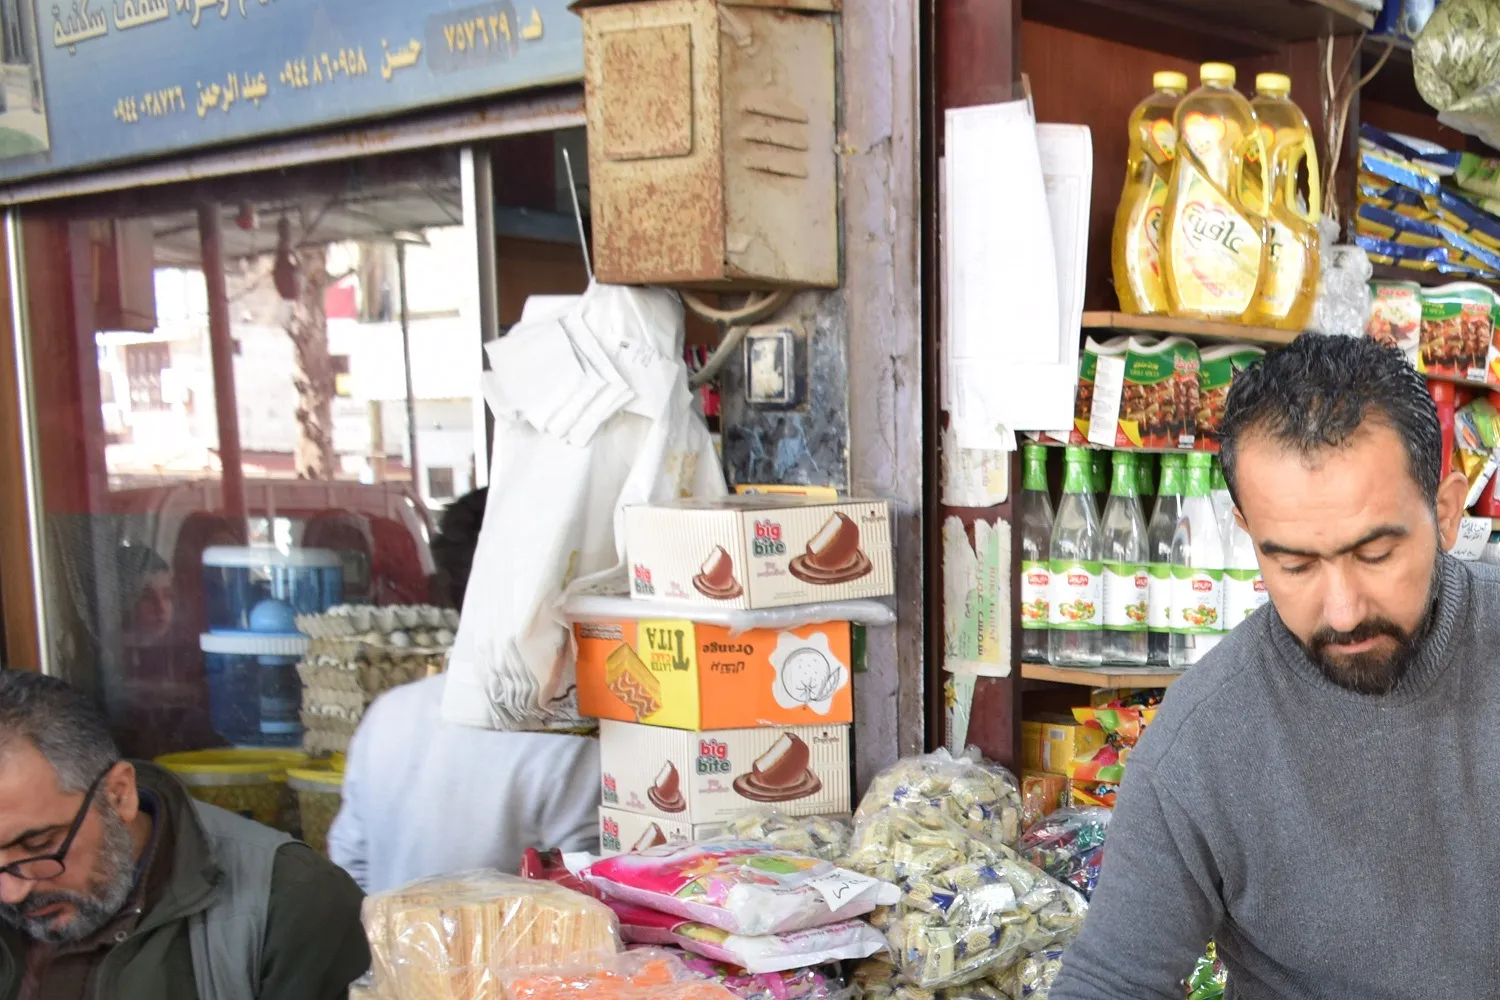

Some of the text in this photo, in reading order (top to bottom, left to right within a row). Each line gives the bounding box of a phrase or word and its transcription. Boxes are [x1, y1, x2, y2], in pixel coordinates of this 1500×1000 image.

[380, 37, 422, 82] حسن
[196, 71, 238, 118] الرحمن
[241, 71, 268, 108] عبد
[754, 519, 782, 541] big
[752, 537, 786, 558] bite
[633, 563, 652, 583] big
[634, 579, 655, 595] bite
[646, 627, 690, 672] TITA
[702, 643, 754, 656] Orange
[700, 739, 728, 760] big
[696, 756, 731, 776] bite
[602, 816, 619, 838] big
[602, 831, 621, 851] bite
